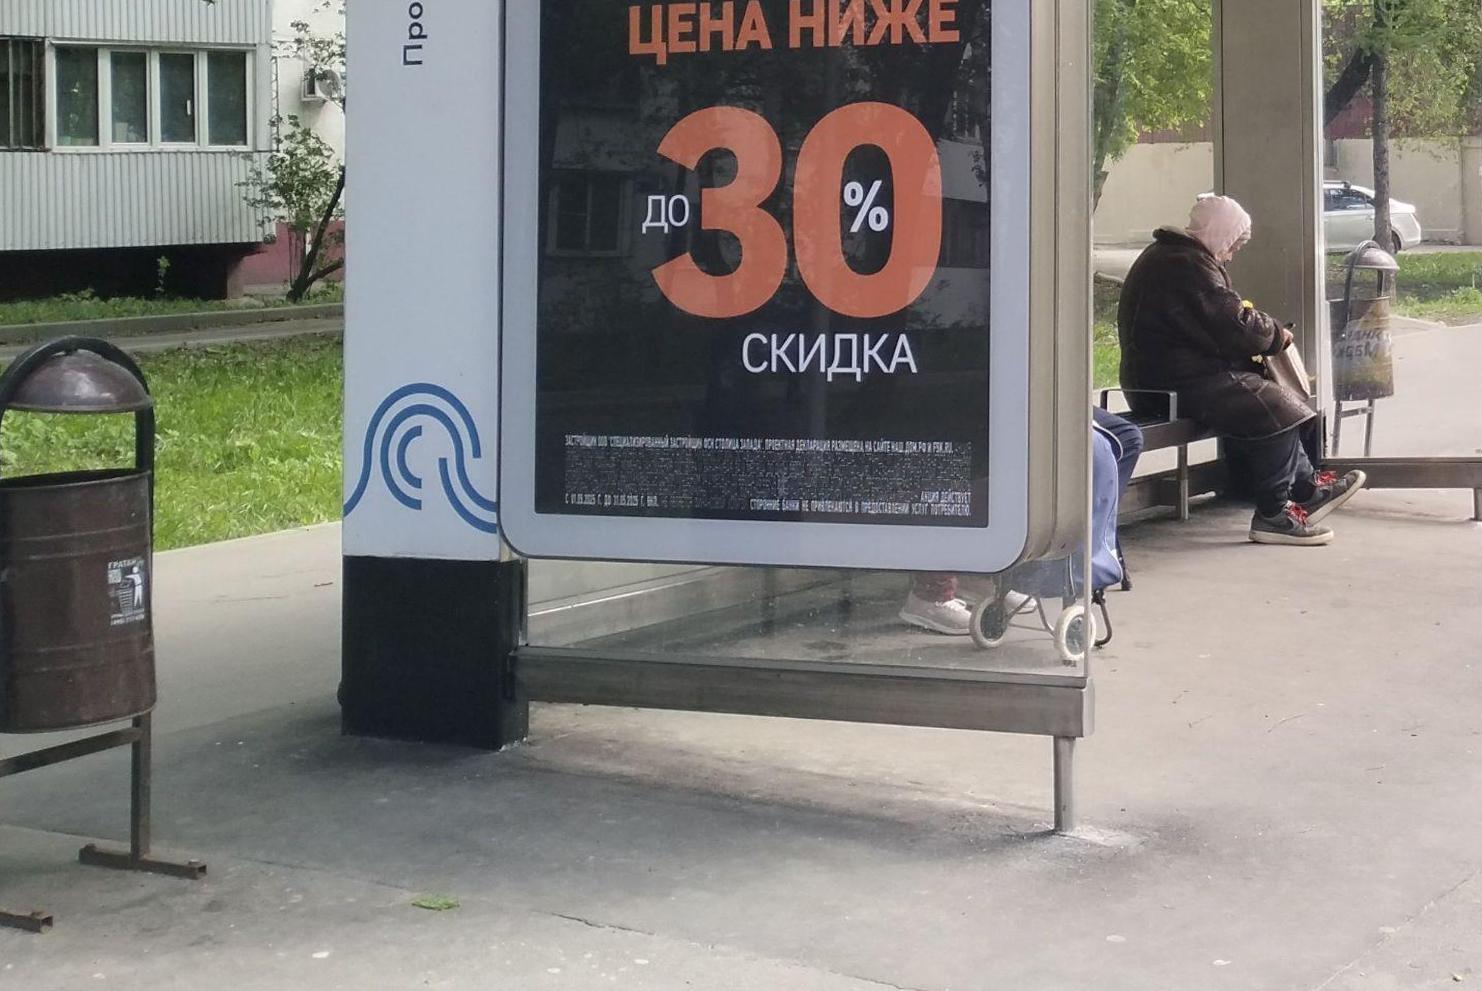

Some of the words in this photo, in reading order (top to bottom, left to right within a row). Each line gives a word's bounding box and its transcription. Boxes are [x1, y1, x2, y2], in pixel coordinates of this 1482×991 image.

[628, 0, 773, 65] ЦЕНА
[641, 194, 691, 235] ДО
[651, 101, 943, 319] 30
[741, 332, 918, 383] СКИДКА
